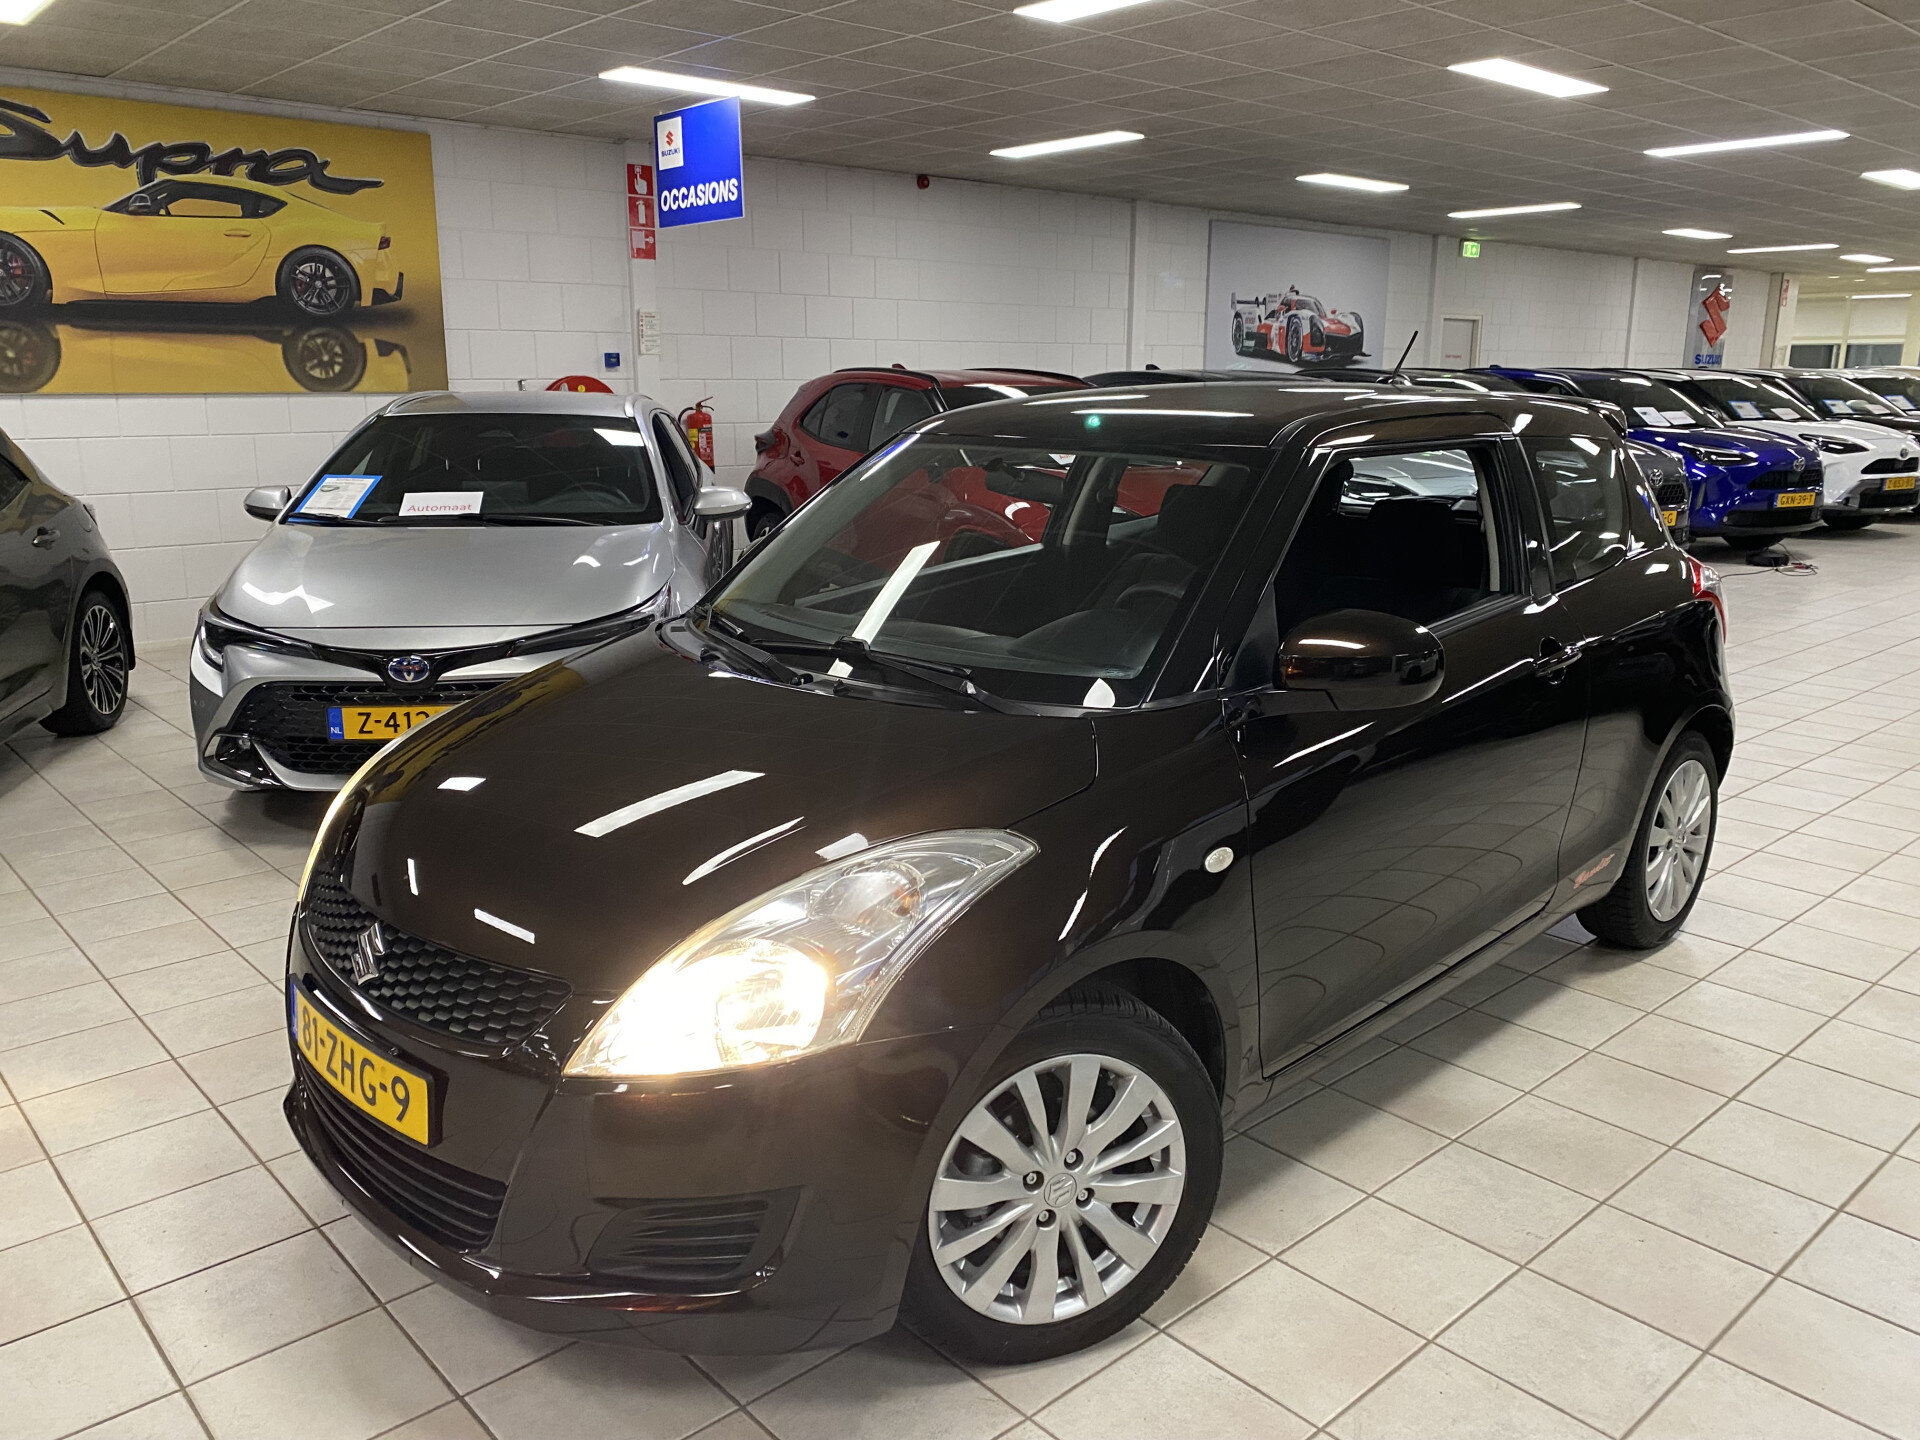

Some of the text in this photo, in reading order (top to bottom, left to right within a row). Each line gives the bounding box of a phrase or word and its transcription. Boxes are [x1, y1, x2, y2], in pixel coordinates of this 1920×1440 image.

[0, 99, 385, 195] Supra
[661, 178, 738, 212] OCCASIONS
[407, 504, 473, 513] Automaat
[1780, 494, 1814, 506] GXN-39-T
[302, 1005, 410, 1122] 81-ZHG-9
